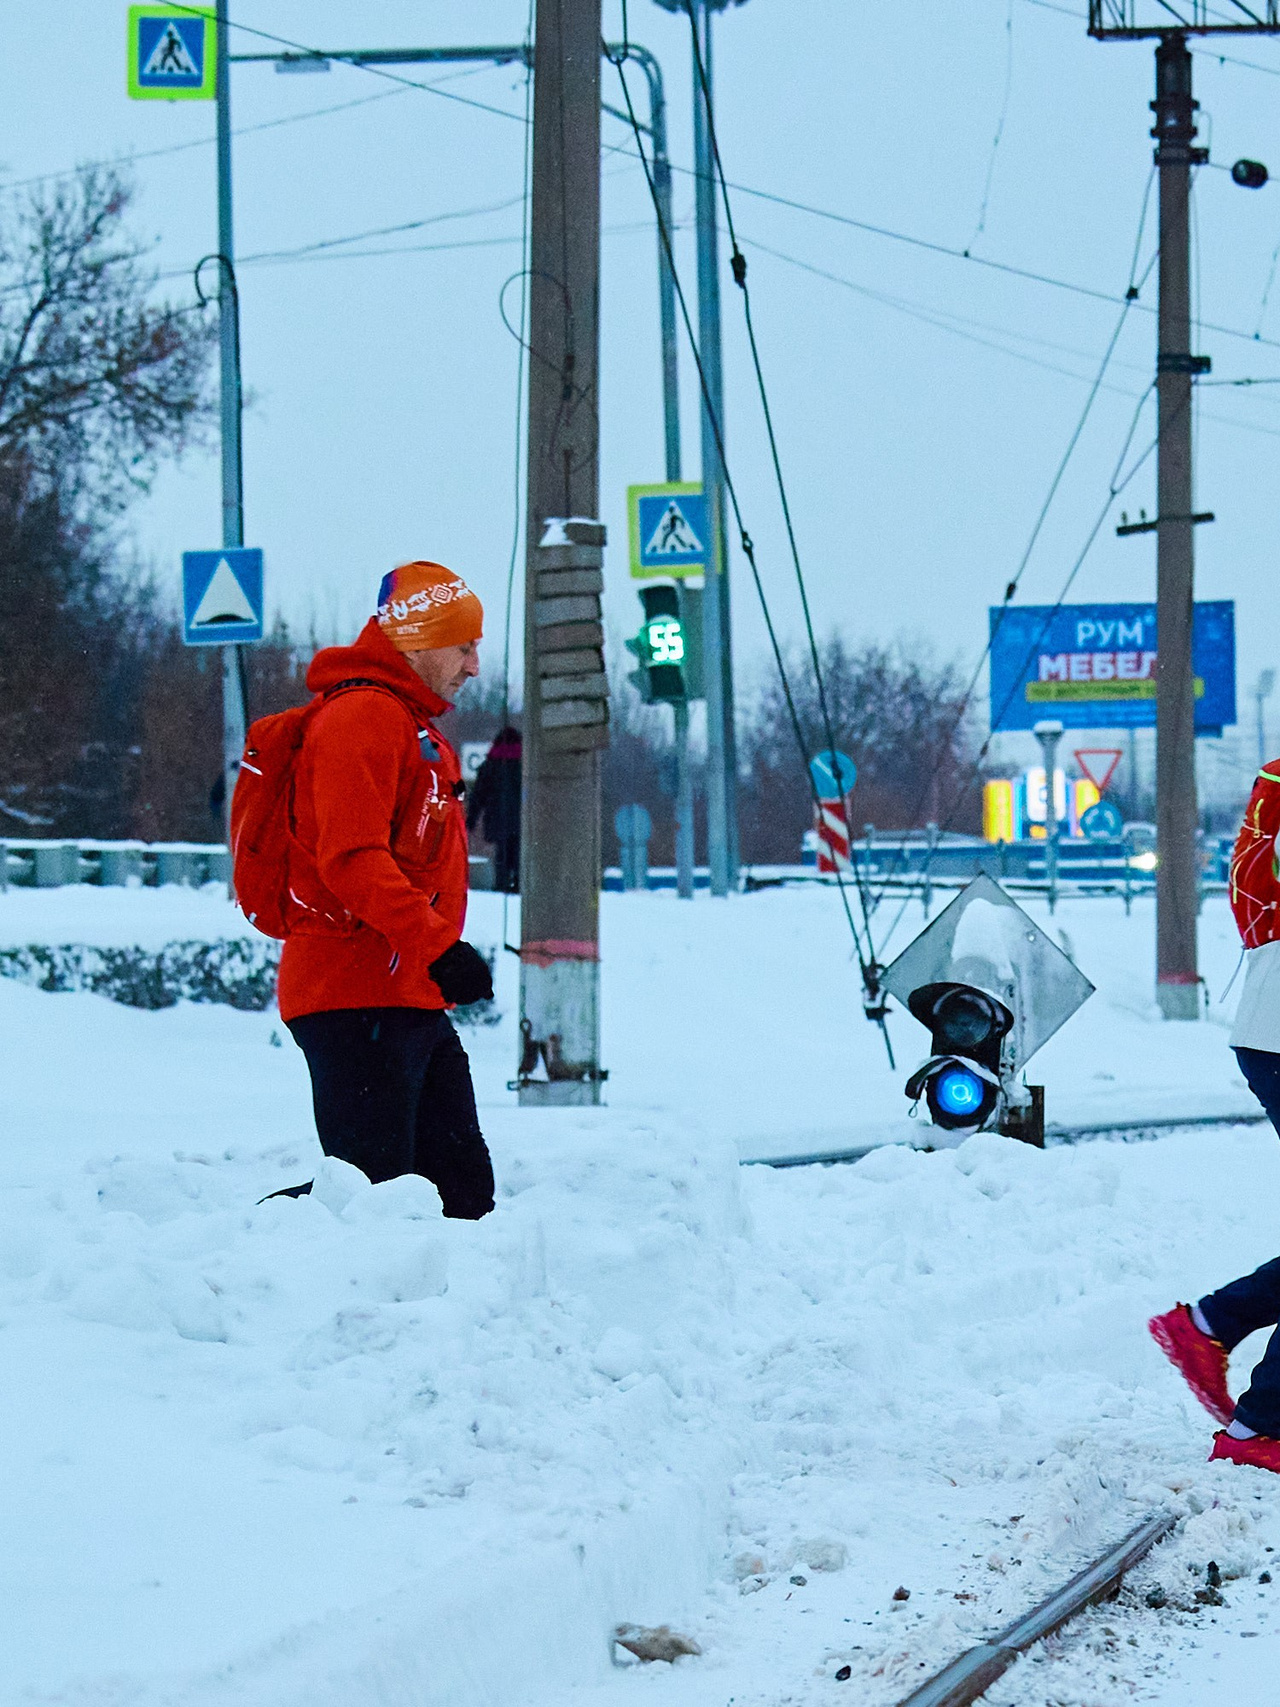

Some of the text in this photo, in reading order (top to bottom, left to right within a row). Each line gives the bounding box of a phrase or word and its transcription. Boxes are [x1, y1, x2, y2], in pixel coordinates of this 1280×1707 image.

[649, 622, 684, 661] 55
[1076, 619, 1143, 647] РУМ
[1038, 652, 1157, 681] МЕБЕЛ
